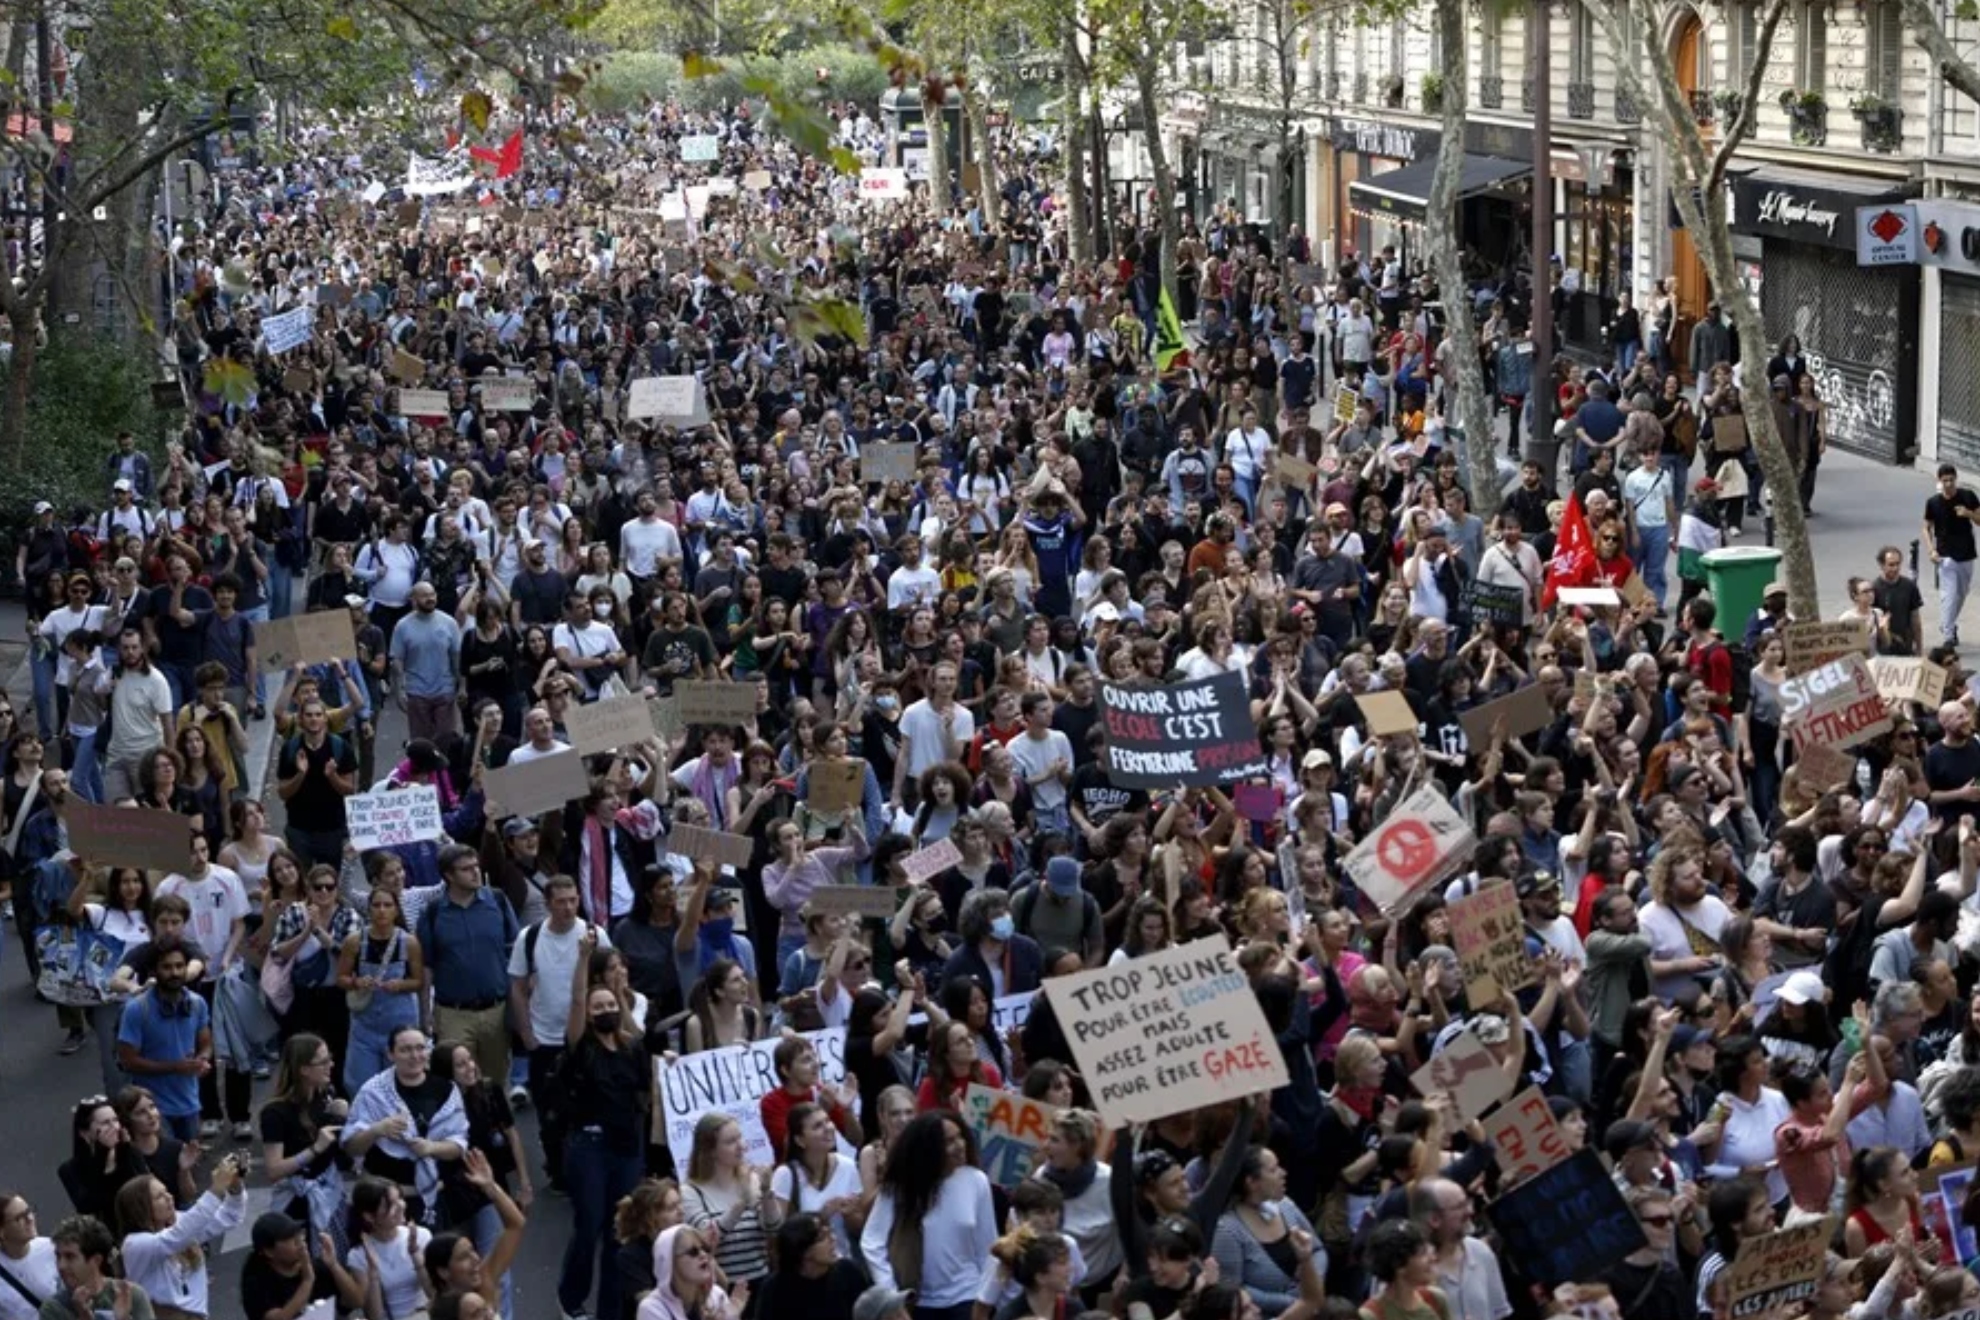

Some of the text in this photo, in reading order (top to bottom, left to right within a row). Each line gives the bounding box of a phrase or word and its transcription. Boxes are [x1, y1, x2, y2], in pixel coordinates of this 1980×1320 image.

[1872, 254, 1906, 262] CENTER
[1102, 685, 1219, 714] OUVRIR UNE
[1165, 712, 1223, 740] C'EST
[1071, 952, 1236, 1012] TROP JEUNE
[1073, 1010, 1129, 1043] POUR
[1131, 997, 1174, 1022] ÊTRE
[1142, 1011, 1191, 1039] MAIS
[1096, 1021, 1231, 1076] ASSEZ ADULTE
[1101, 1031, 1272, 1103] POUR ÊTRE GAZÉ
[1735, 1268, 1771, 1292] LES
[1734, 1293, 1763, 1316] LES
